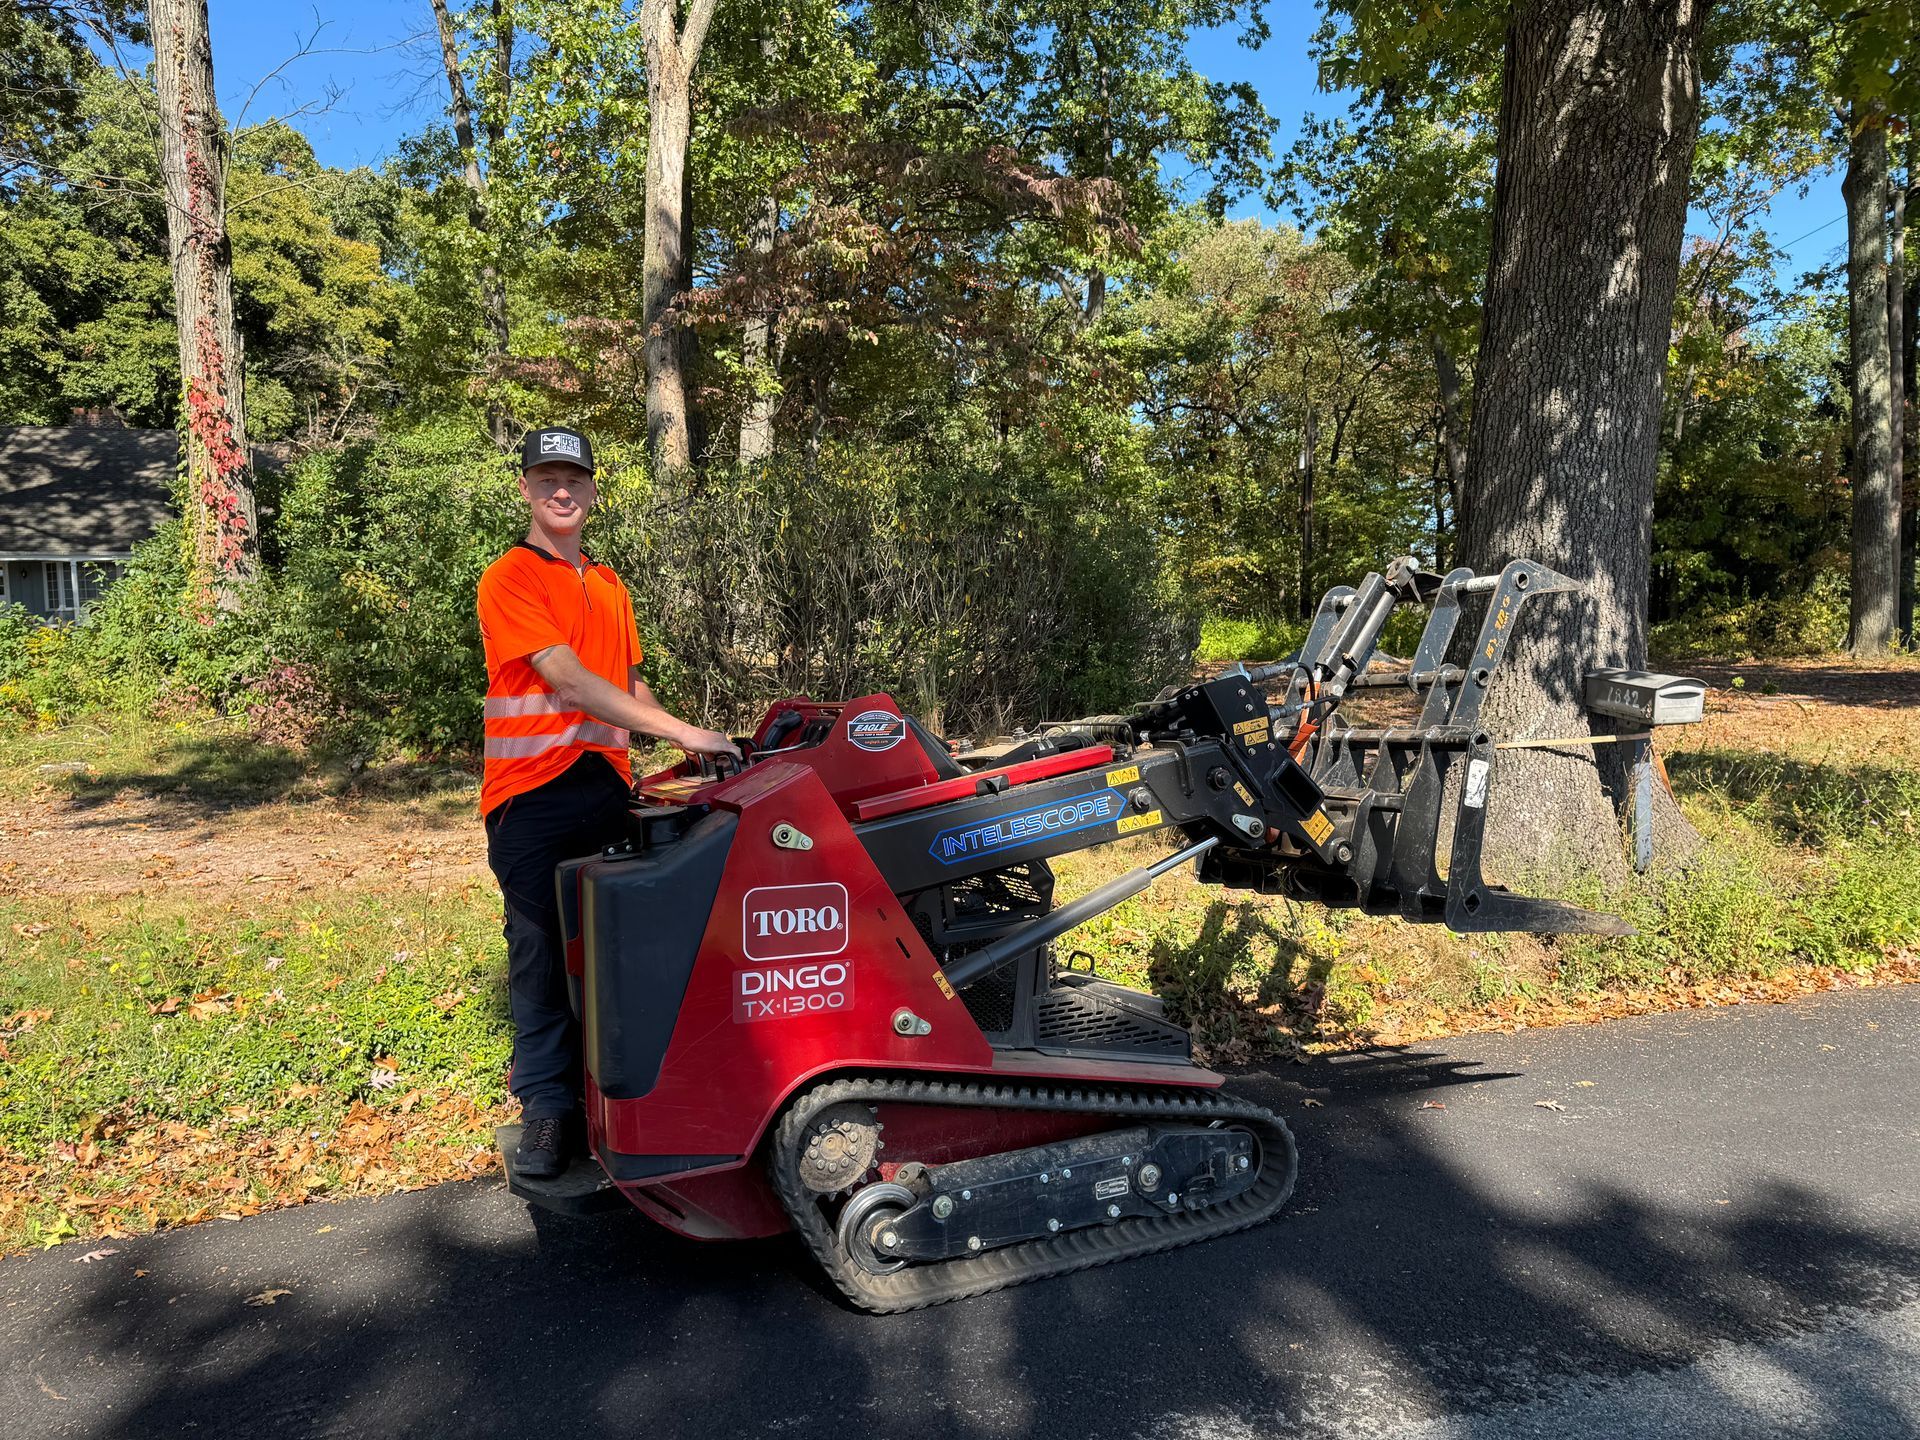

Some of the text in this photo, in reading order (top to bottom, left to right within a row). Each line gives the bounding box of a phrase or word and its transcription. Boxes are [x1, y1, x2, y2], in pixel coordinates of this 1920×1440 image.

[562, 439, 579, 449] USE
[854, 723, 889, 732] EAGLE
[942, 796, 1110, 857] INTELESCOPE
[752, 905, 840, 937] TORO
[741, 963, 847, 996] DINGO
